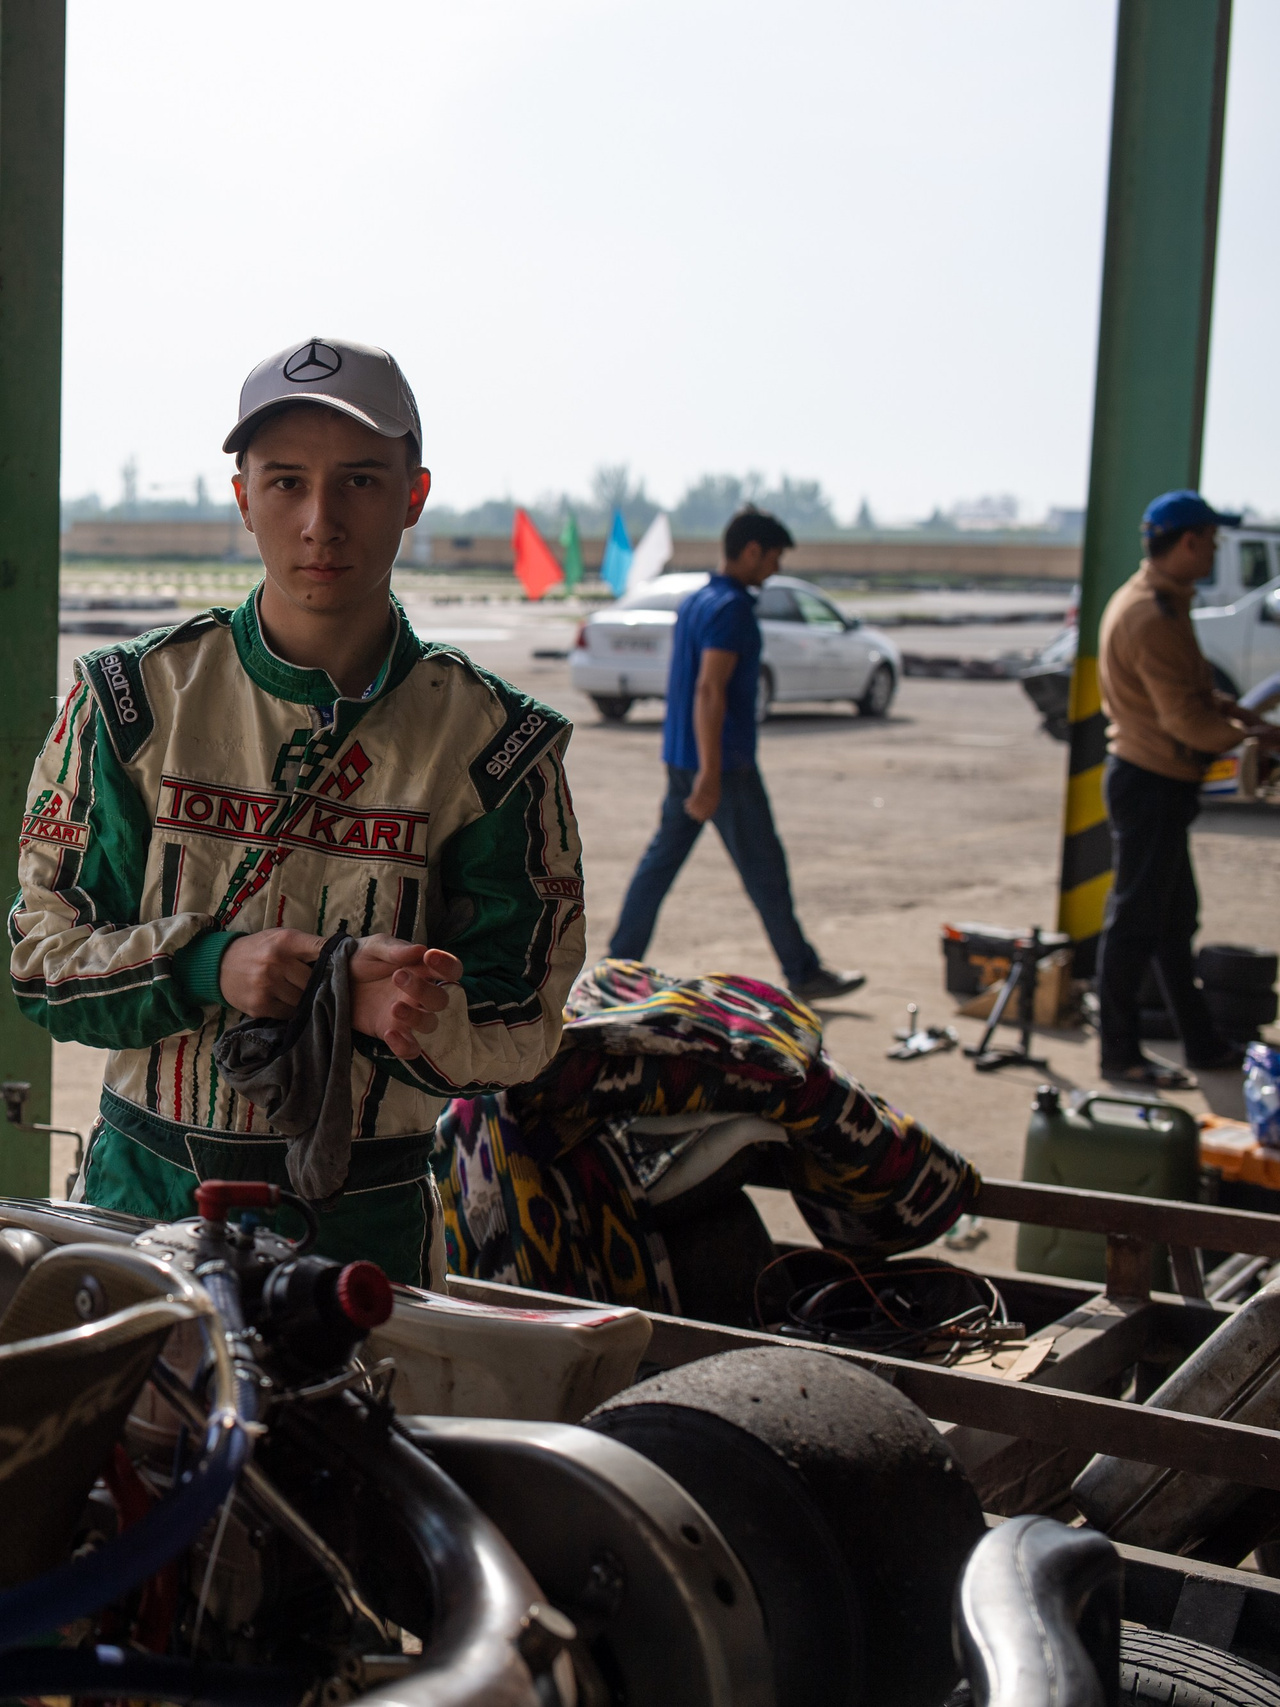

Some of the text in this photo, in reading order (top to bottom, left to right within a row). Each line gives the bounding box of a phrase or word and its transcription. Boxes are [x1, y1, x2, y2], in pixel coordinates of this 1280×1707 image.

[100, 654, 139, 723] sparco
[486, 713, 544, 778] sparco
[37, 819, 87, 842] KART
[163, 779, 429, 852] TONY KART
[536, 880, 581, 897] TONY
